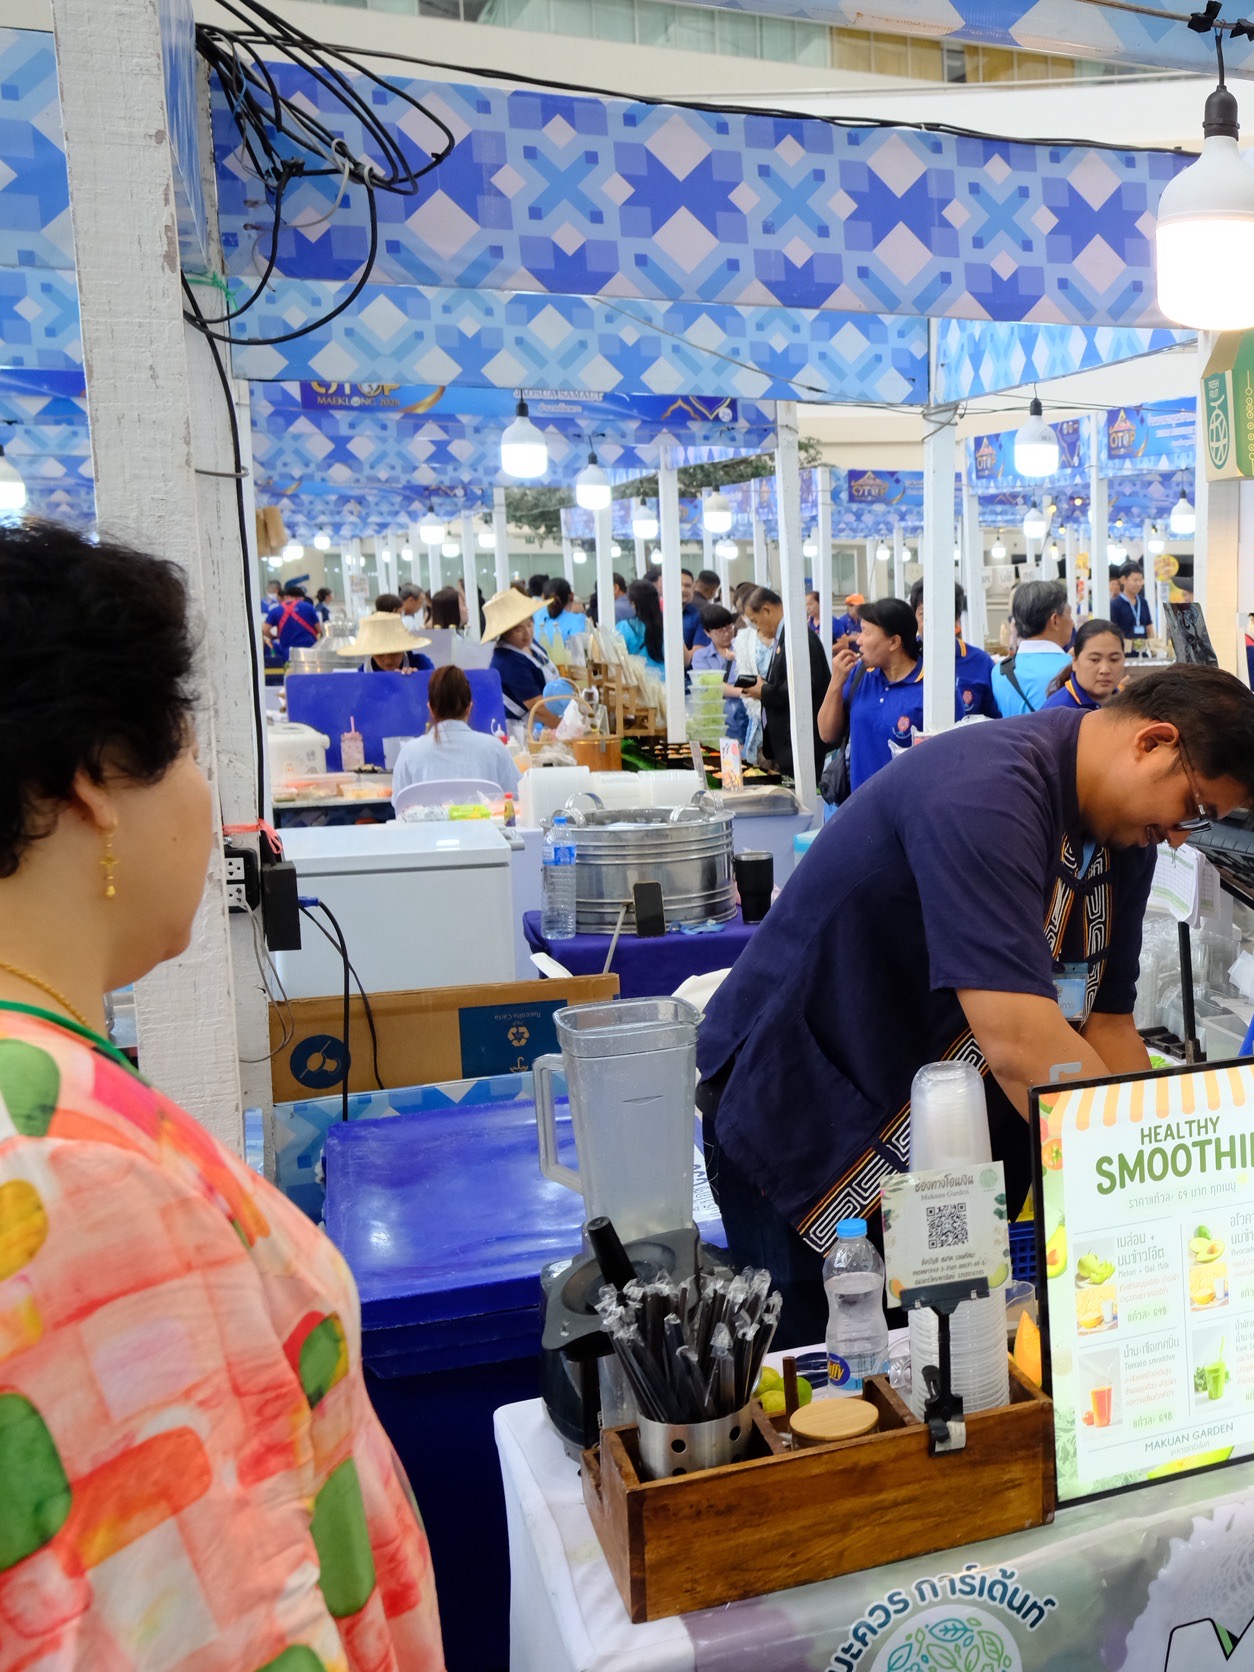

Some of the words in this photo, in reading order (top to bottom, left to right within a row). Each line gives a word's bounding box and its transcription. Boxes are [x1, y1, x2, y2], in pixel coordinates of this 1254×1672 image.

[1109, 430, 1136, 449] OTOP
[1140, 1115, 1220, 1145] HEALTHY
[915, 1174, 975, 1193] ช่องทางโอนเงิน
[921, 1192, 945, 1201] Makuan
[1178, 1190, 1188, 1201] 69
[1191, 1186, 1208, 1199] บาท
[1116, 1231, 1146, 1249] เมล่อน
[1117, 1246, 1165, 1267] นมข้าวโอ๊ต
[1117, 1269, 1137, 1280] Melon
[1124, 1360, 1148, 1371] Tomato
[1144, 1433, 1189, 1453] MAKUAN
[1192, 1422, 1234, 1441] GARDEN
[829, 1589, 910, 1672] มะควร
